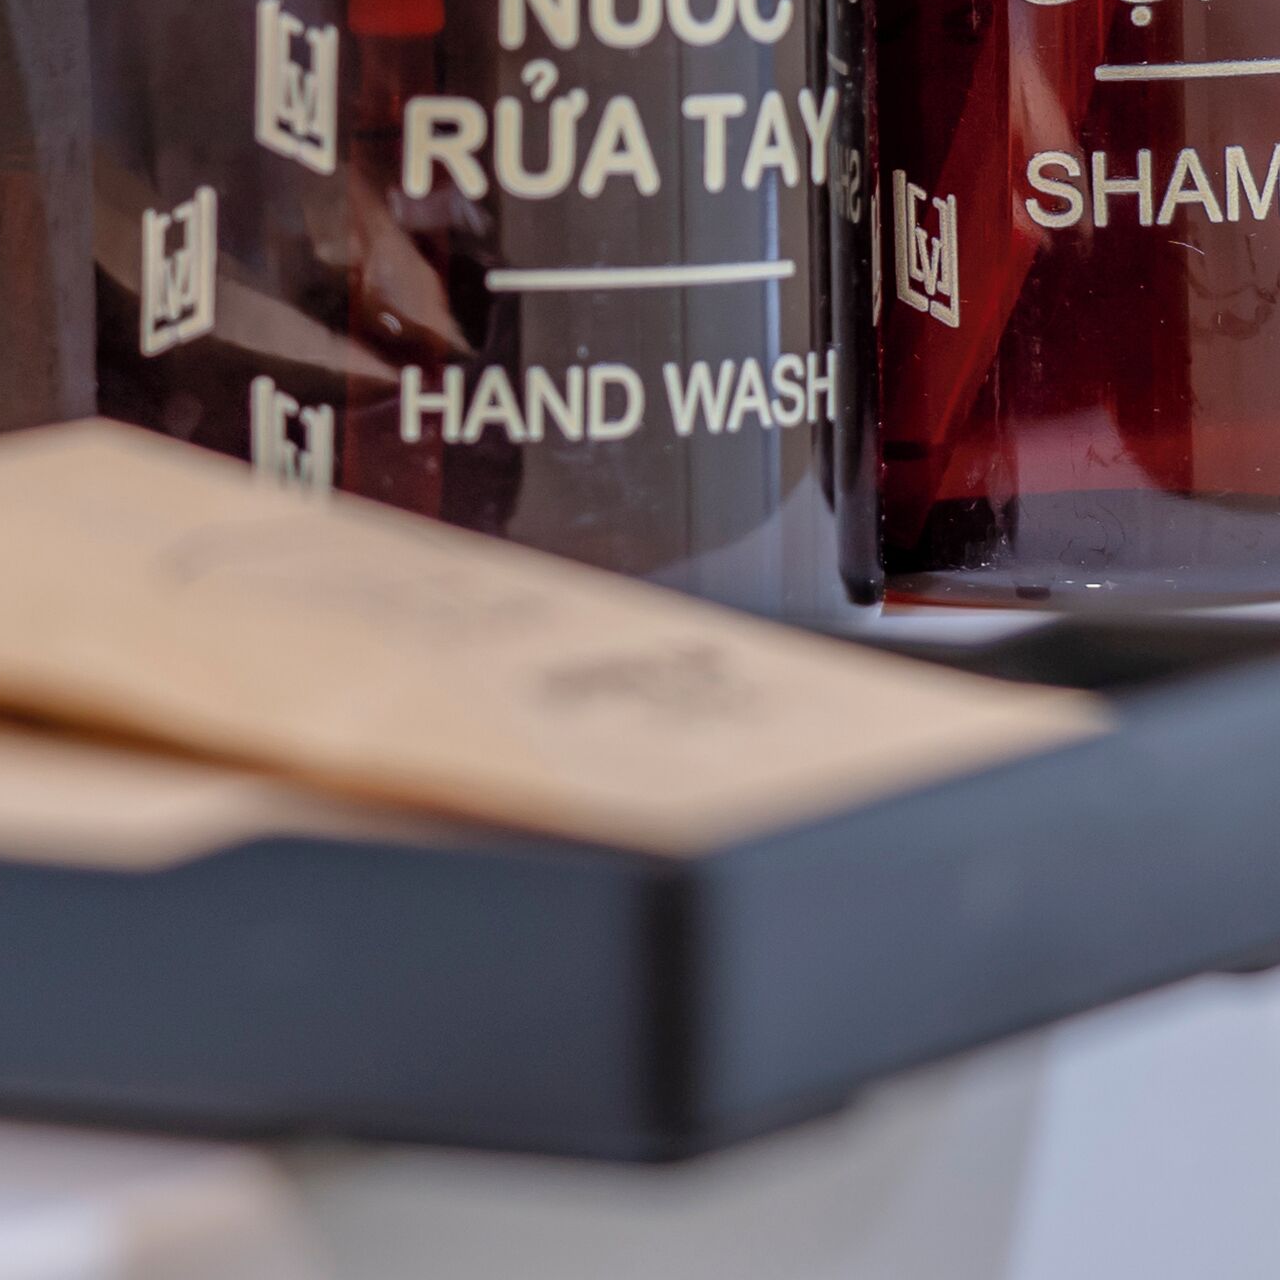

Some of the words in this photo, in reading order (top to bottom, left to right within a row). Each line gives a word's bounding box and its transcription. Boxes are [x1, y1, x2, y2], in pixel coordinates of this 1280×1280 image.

[402, 59, 661, 200] RỬA
[683, 87, 839, 191] TAY
[400, 364, 646, 443] HAND
[664, 352, 840, 435] WASH
